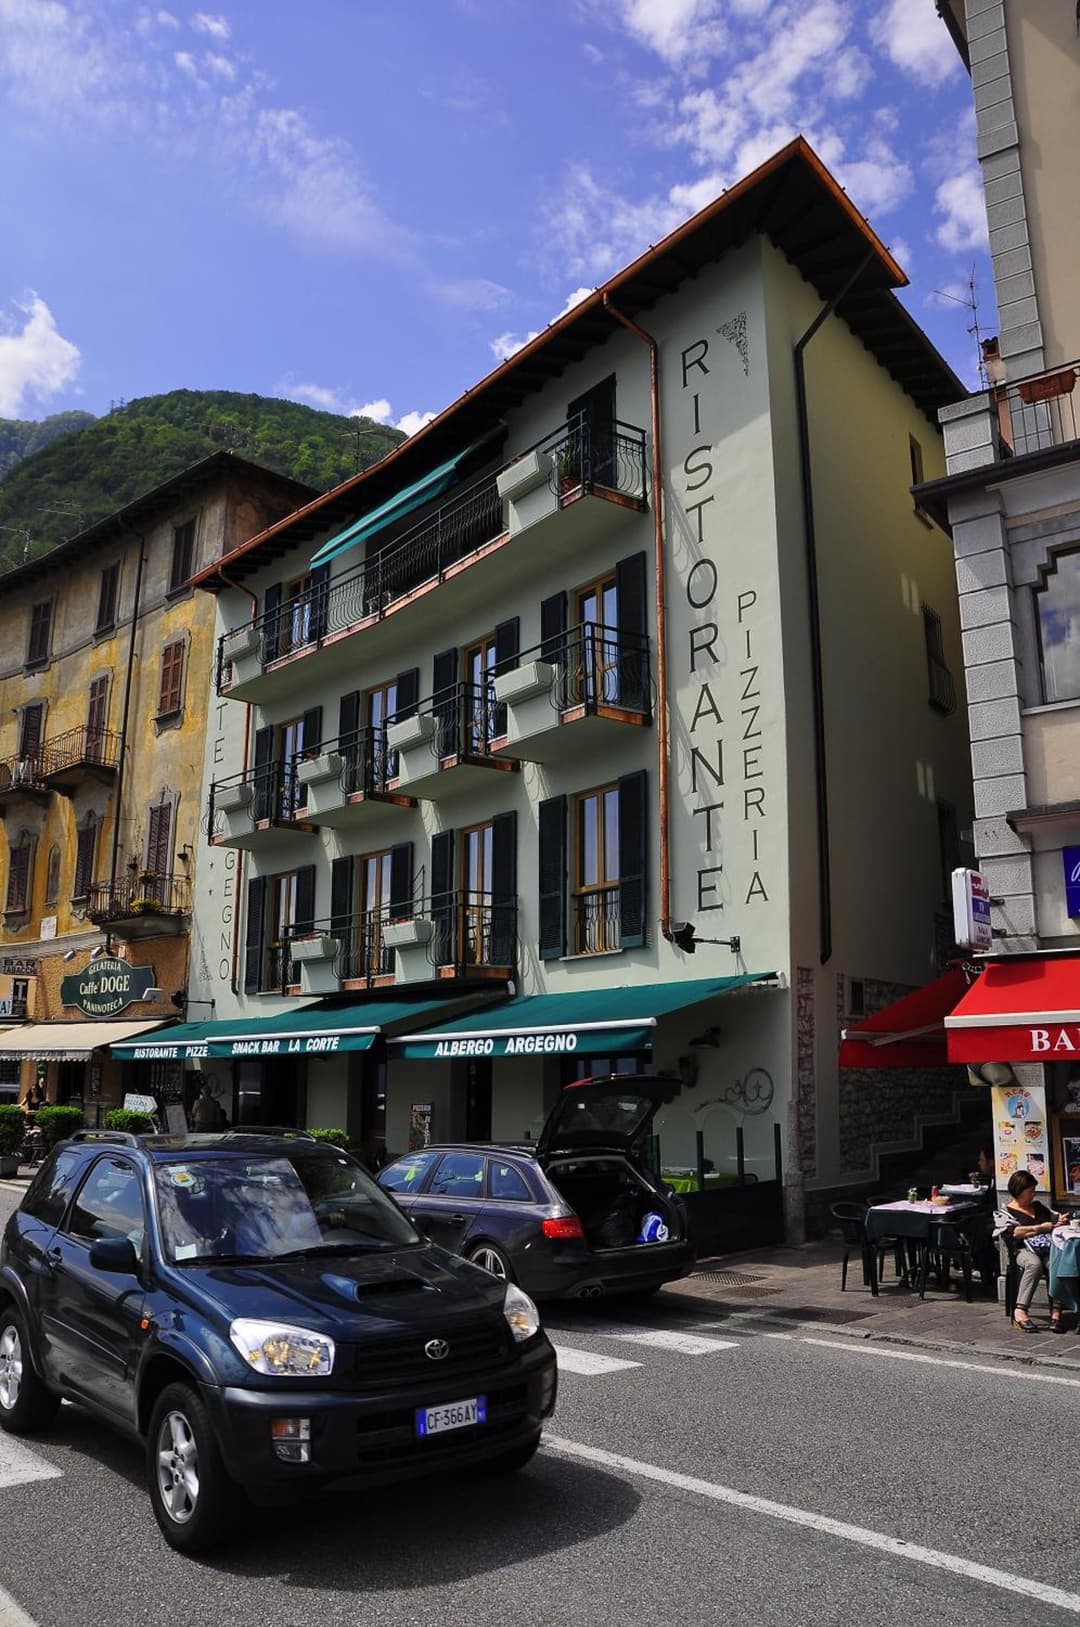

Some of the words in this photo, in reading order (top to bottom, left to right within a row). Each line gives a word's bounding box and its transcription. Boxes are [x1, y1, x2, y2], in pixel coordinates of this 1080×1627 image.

[681, 339, 724, 912] RISTORANTE
[737, 590, 769, 905] PIZZERIA
[218, 851, 235, 981] GEGNO
[4, 959, 36, 967] BAR
[88, 960, 122, 975] GELATERIA
[100, 974, 131, 994] DOGE
[82, 997, 124, 1014] PANINOTECA
[231, 1040, 260, 1055] SNACK
[261, 1040, 281, 1053] BAR
[288, 1038, 301, 1052] LA
[306, 1036, 339, 1051] CORTE
[434, 1038, 495, 1057] ALBERGO
[504, 1033, 578, 1054] ARGEGNO
[1029, 1028, 1080, 1052] BA
[133, 1046, 178, 1059] RISTORANTE
